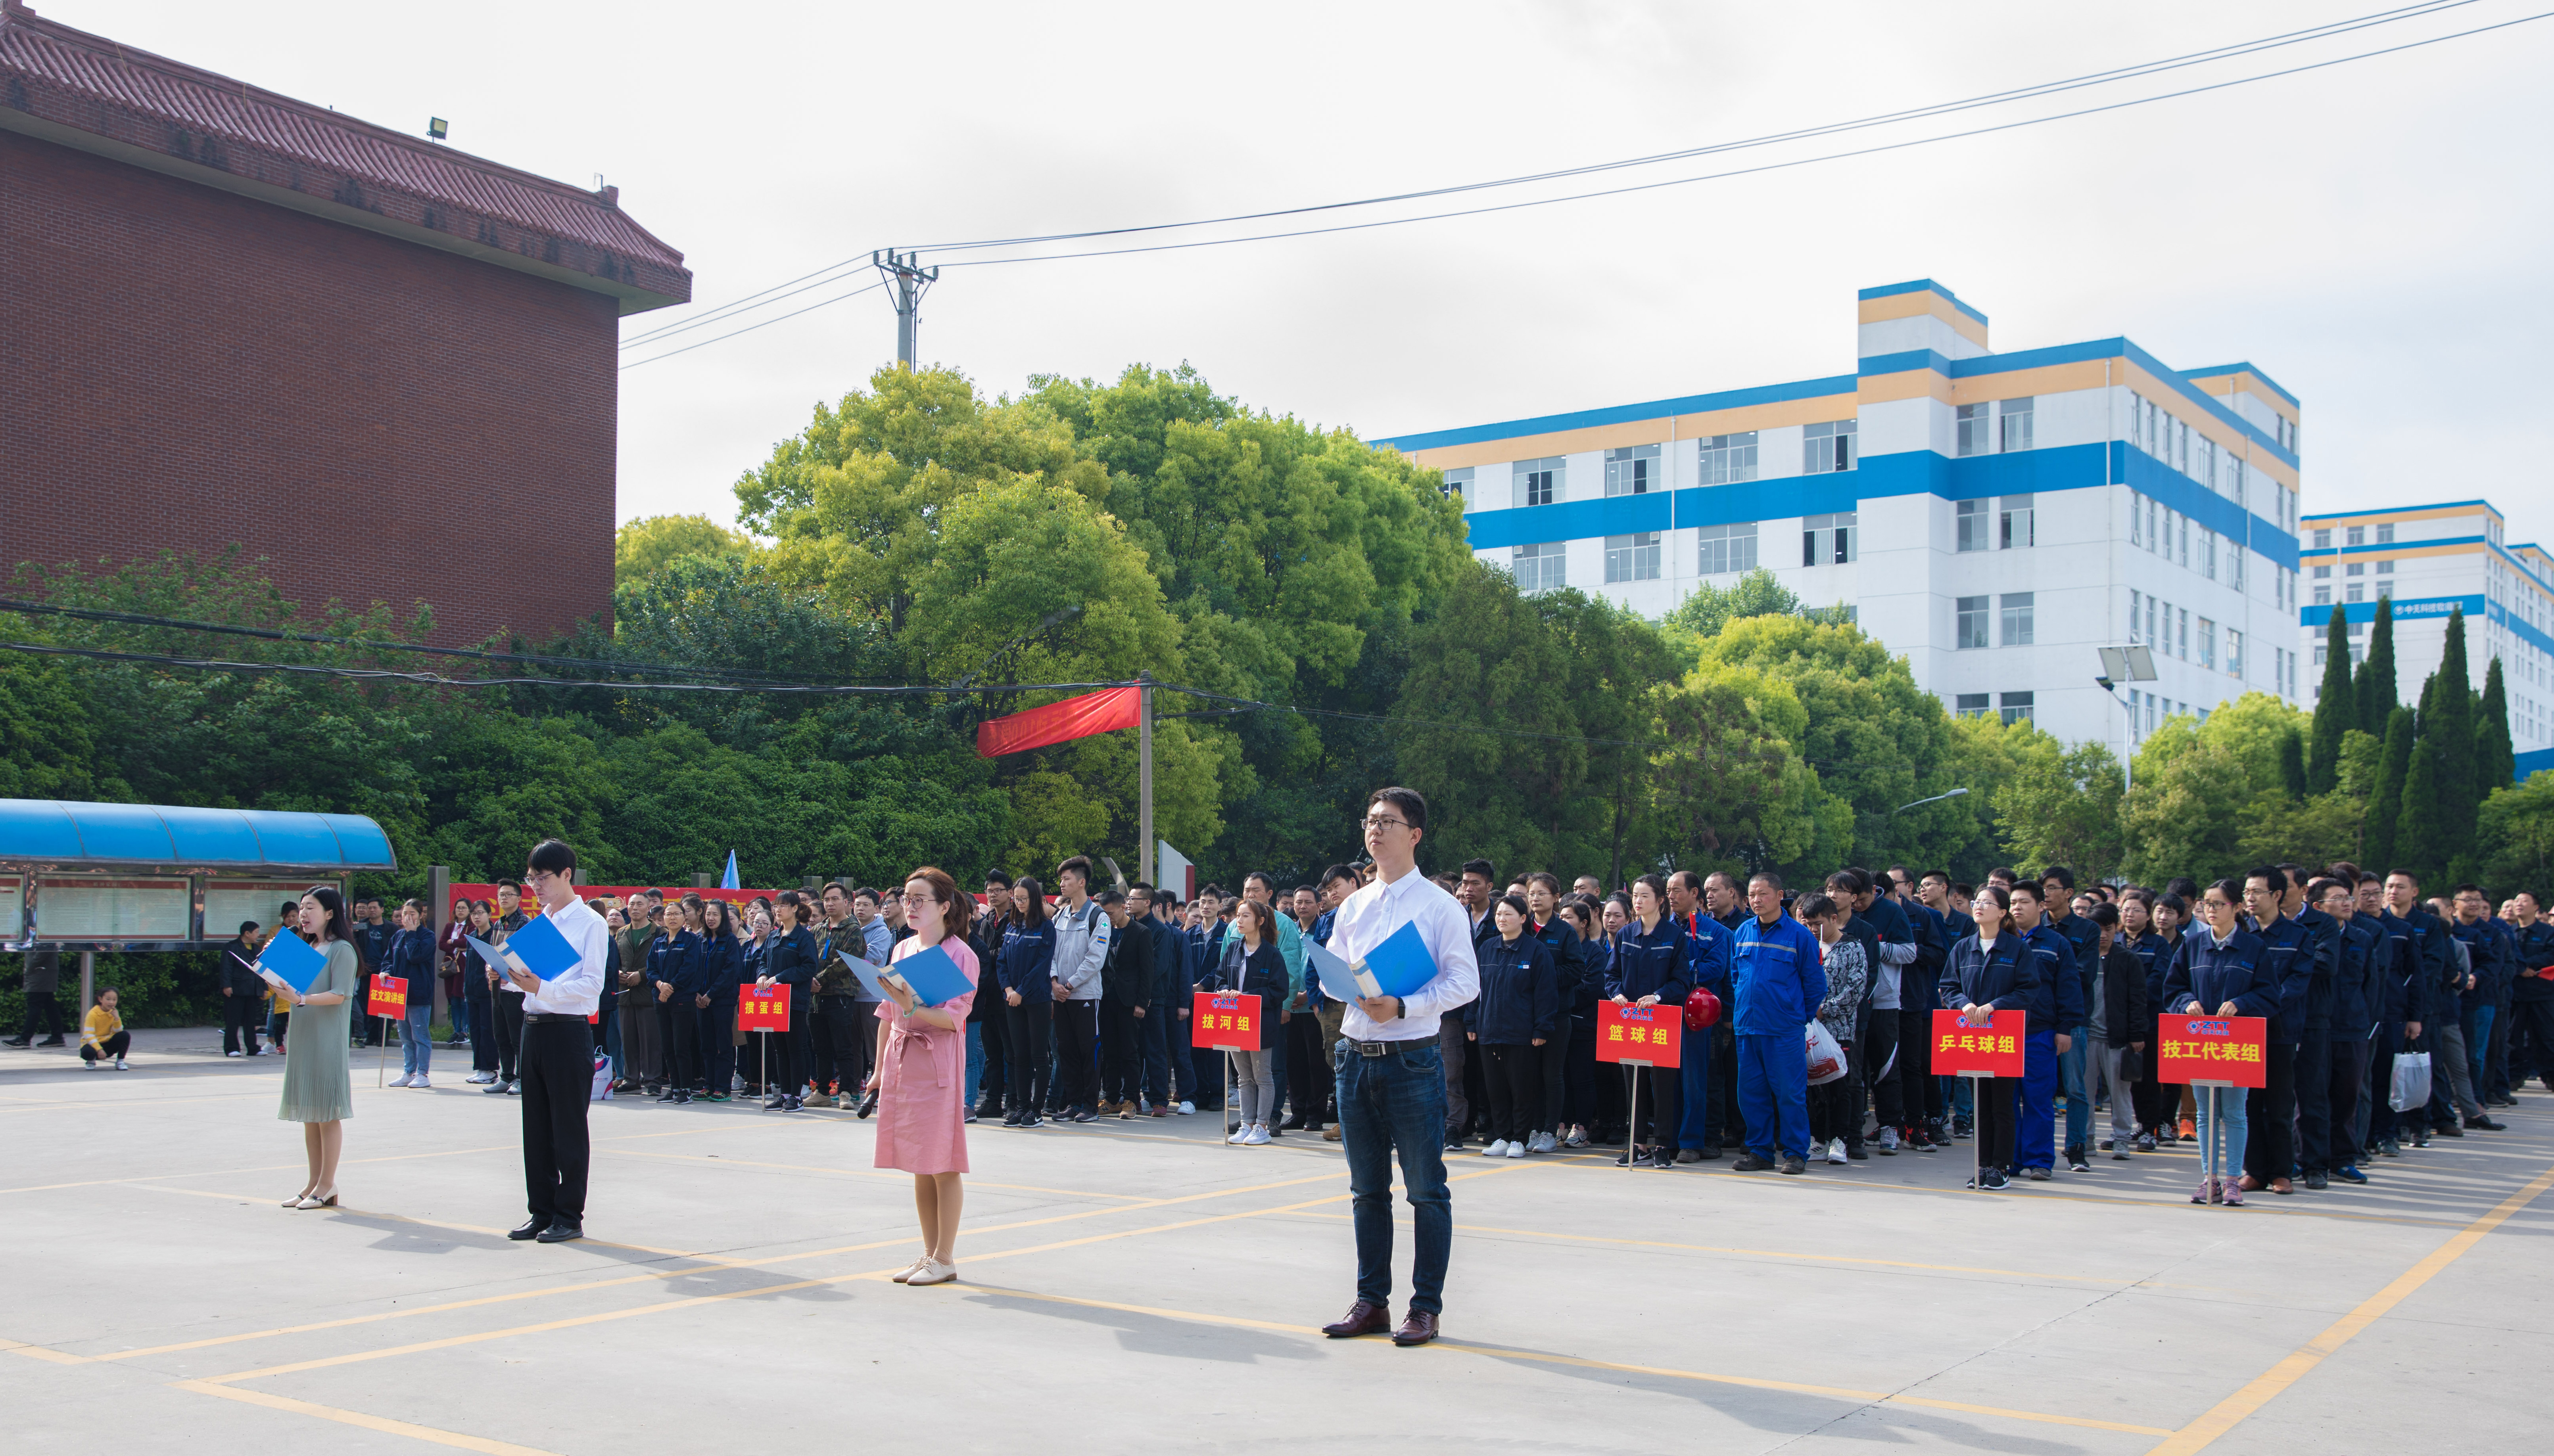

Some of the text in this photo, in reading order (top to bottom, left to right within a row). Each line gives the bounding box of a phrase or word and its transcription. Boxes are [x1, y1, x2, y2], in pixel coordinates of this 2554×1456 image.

[371, 989, 405, 1004] 征文演讲组
[745, 1001, 783, 1014] 掼蛋组
[1202, 1014, 1250, 1031] 拔河组
[2201, 1021, 2230, 1029] ZTT
[1609, 1024, 1668, 1045] 篮球组
[1939, 1035, 2015, 1053] 乒乓球组
[2163, 1040, 2260, 1062] 技工代表组
